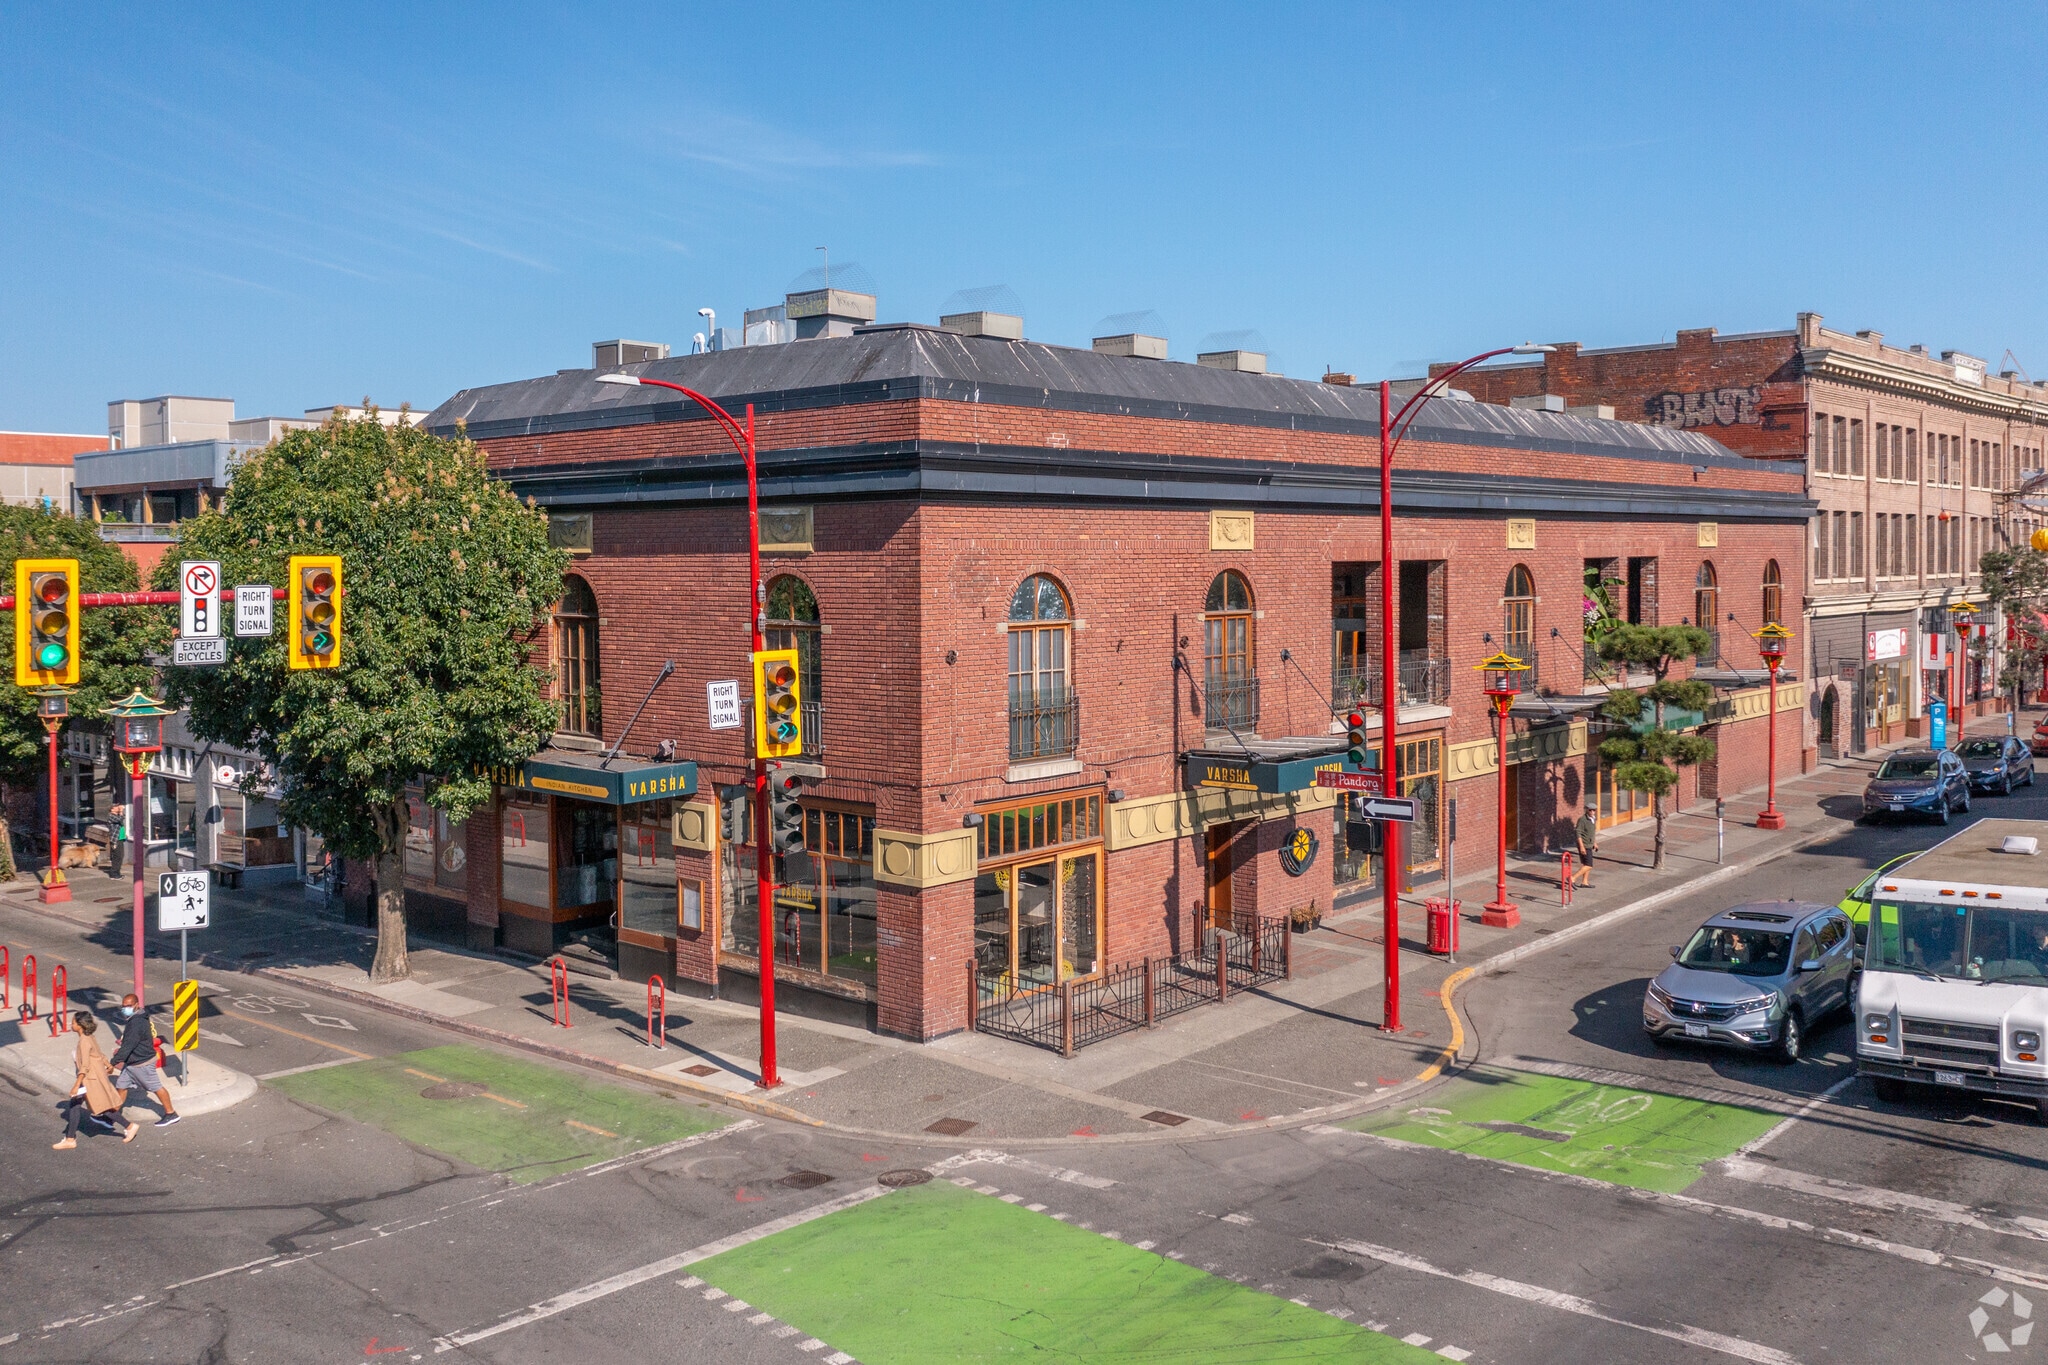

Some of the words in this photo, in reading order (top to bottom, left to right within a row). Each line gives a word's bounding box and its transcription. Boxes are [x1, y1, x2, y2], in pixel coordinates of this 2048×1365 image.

[242, 591, 266, 602] RIGHT
[243, 606, 265, 616] TURN
[239, 620, 268, 630] SIGNAL
[182, 641, 217, 651] EXCEPT
[178, 651, 222, 662] BICYCLES
[713, 685, 733, 697] RIGHT
[715, 699, 734, 710] TURN
[712, 712, 738, 724] SIGNAL
[1206, 766, 1250, 784] VARSHA
[1338, 773, 1379, 789] Pandora
[546, 781, 566, 789] INDIAN
[568, 785, 593, 793] KITCHEN
[630, 775, 685, 797] VARSHA
[781, 886, 812, 902] VARSHA
